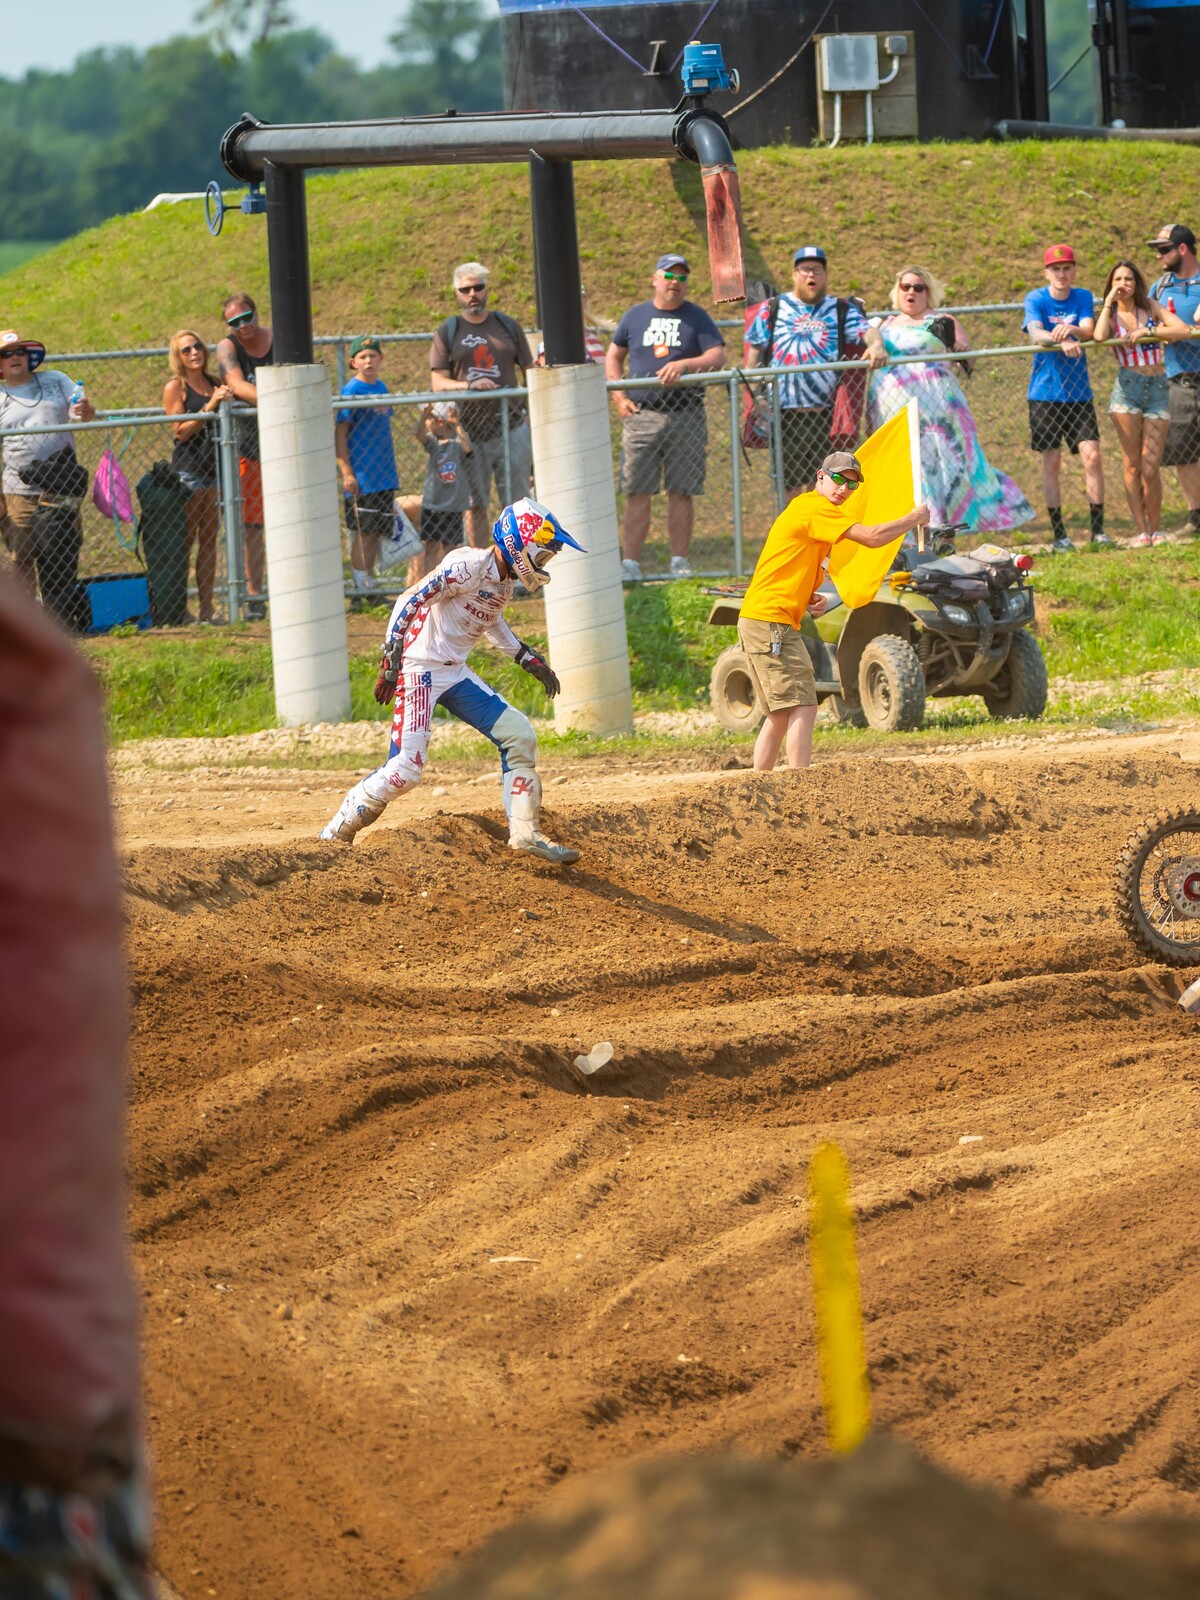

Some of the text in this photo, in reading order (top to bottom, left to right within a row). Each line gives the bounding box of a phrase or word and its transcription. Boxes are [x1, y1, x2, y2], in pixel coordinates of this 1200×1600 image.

[647, 318, 681, 332] JUST
[642, 330, 666, 346] DO
[504, 534, 531, 576] Red Bull
[511, 776, 534, 796] 94
